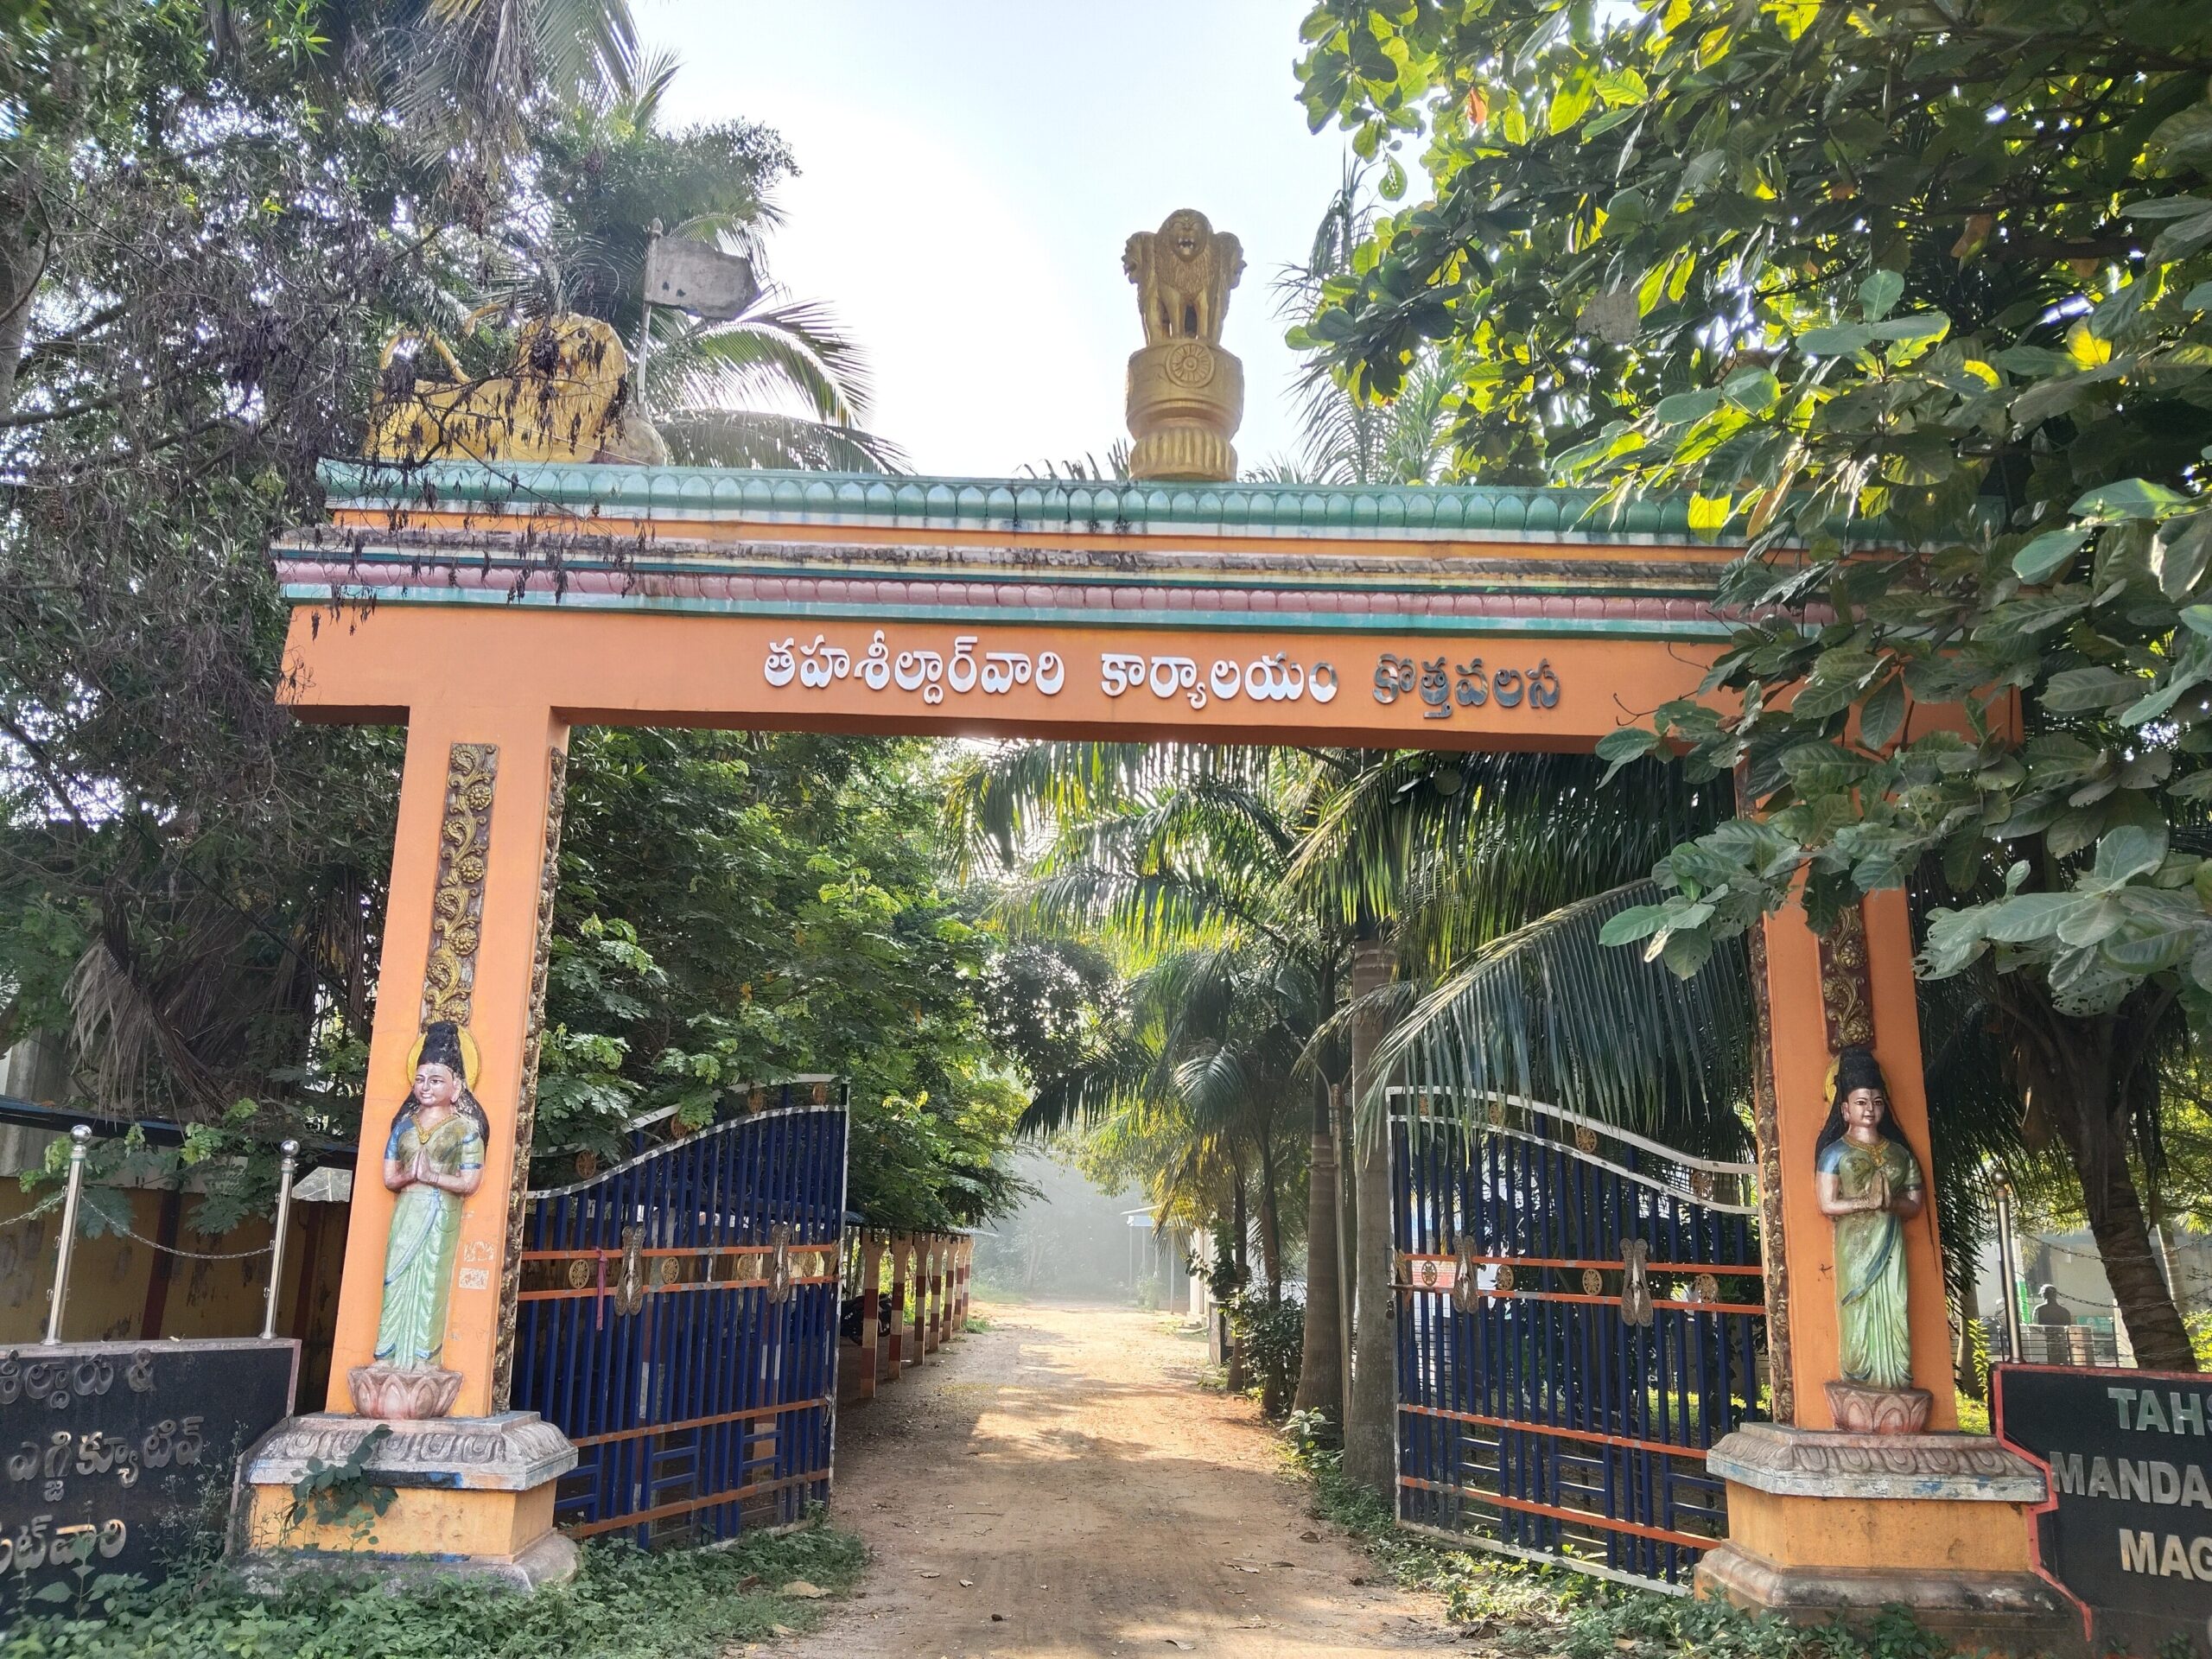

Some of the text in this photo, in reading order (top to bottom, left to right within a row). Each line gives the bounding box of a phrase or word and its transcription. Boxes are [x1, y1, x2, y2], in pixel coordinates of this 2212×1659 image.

[1100, 651, 1338, 710] కార్యాలయం
[1372, 653, 1560, 719] కొత్తవలస
[2107, 1387, 2212, 1436] TAH
